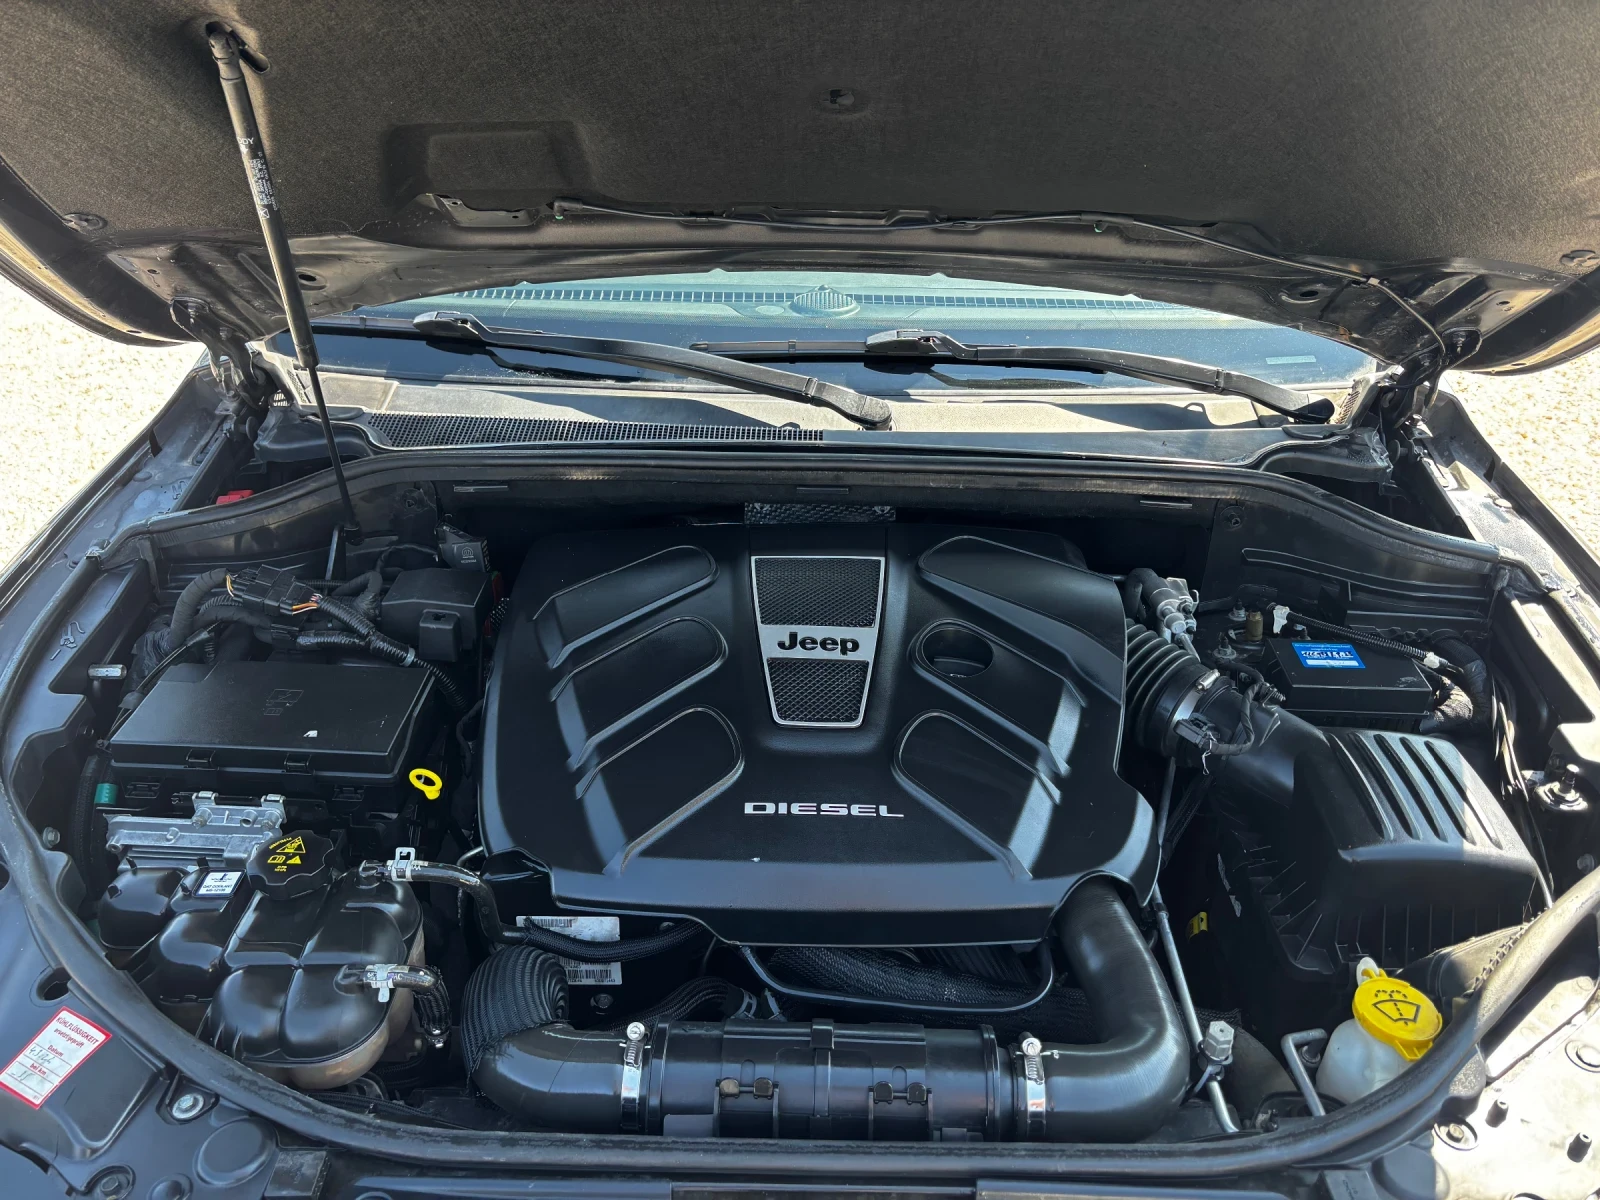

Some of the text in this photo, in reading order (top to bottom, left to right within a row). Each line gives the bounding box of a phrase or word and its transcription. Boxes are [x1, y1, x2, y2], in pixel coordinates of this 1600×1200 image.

[777, 631, 860, 656] Jeep
[744, 802, 904, 817] DIESEL
[56, 1016, 99, 1045] KÜHLFLÜSSIGKEIT
[47, 1044, 64, 1057] Datum
[29, 1063, 47, 1076] bei km
